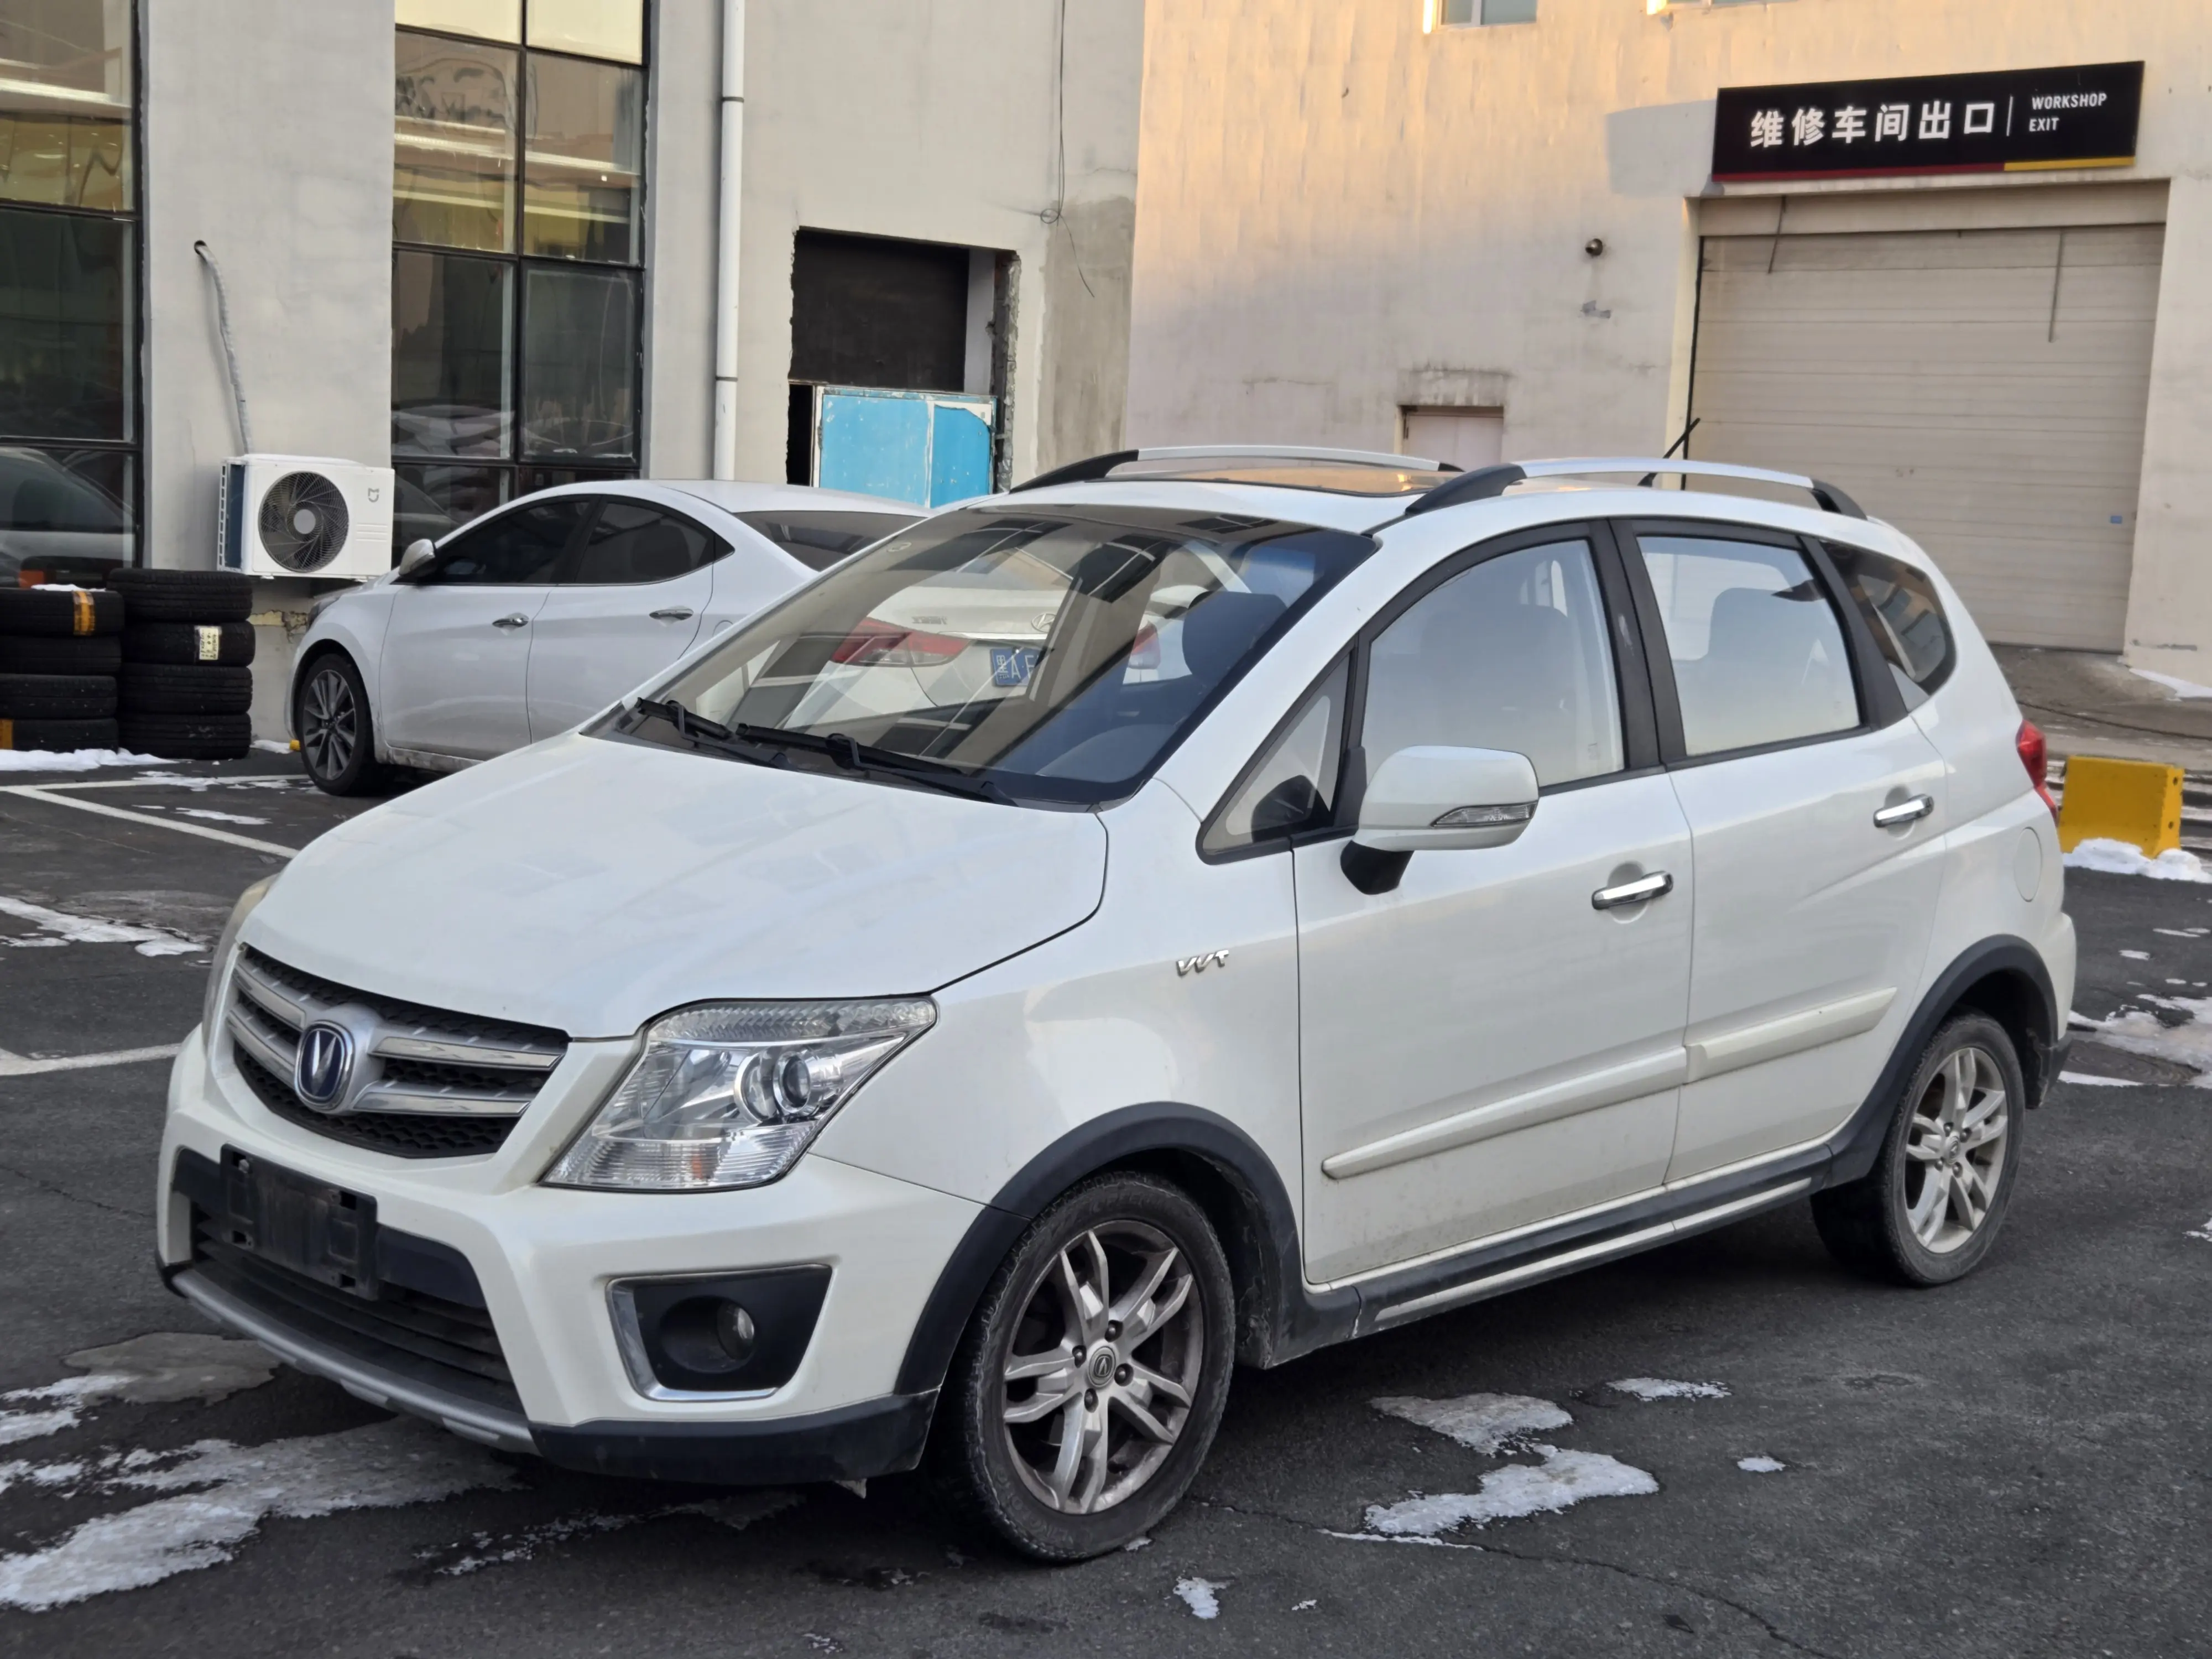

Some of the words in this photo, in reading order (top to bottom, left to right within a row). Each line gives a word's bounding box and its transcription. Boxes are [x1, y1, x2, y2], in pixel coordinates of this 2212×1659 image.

[2031, 92, 2107, 110] WORKSHOP
[1750, 101, 1995, 148] 维修车间出口
[2028, 117, 2059, 132] EXIT
